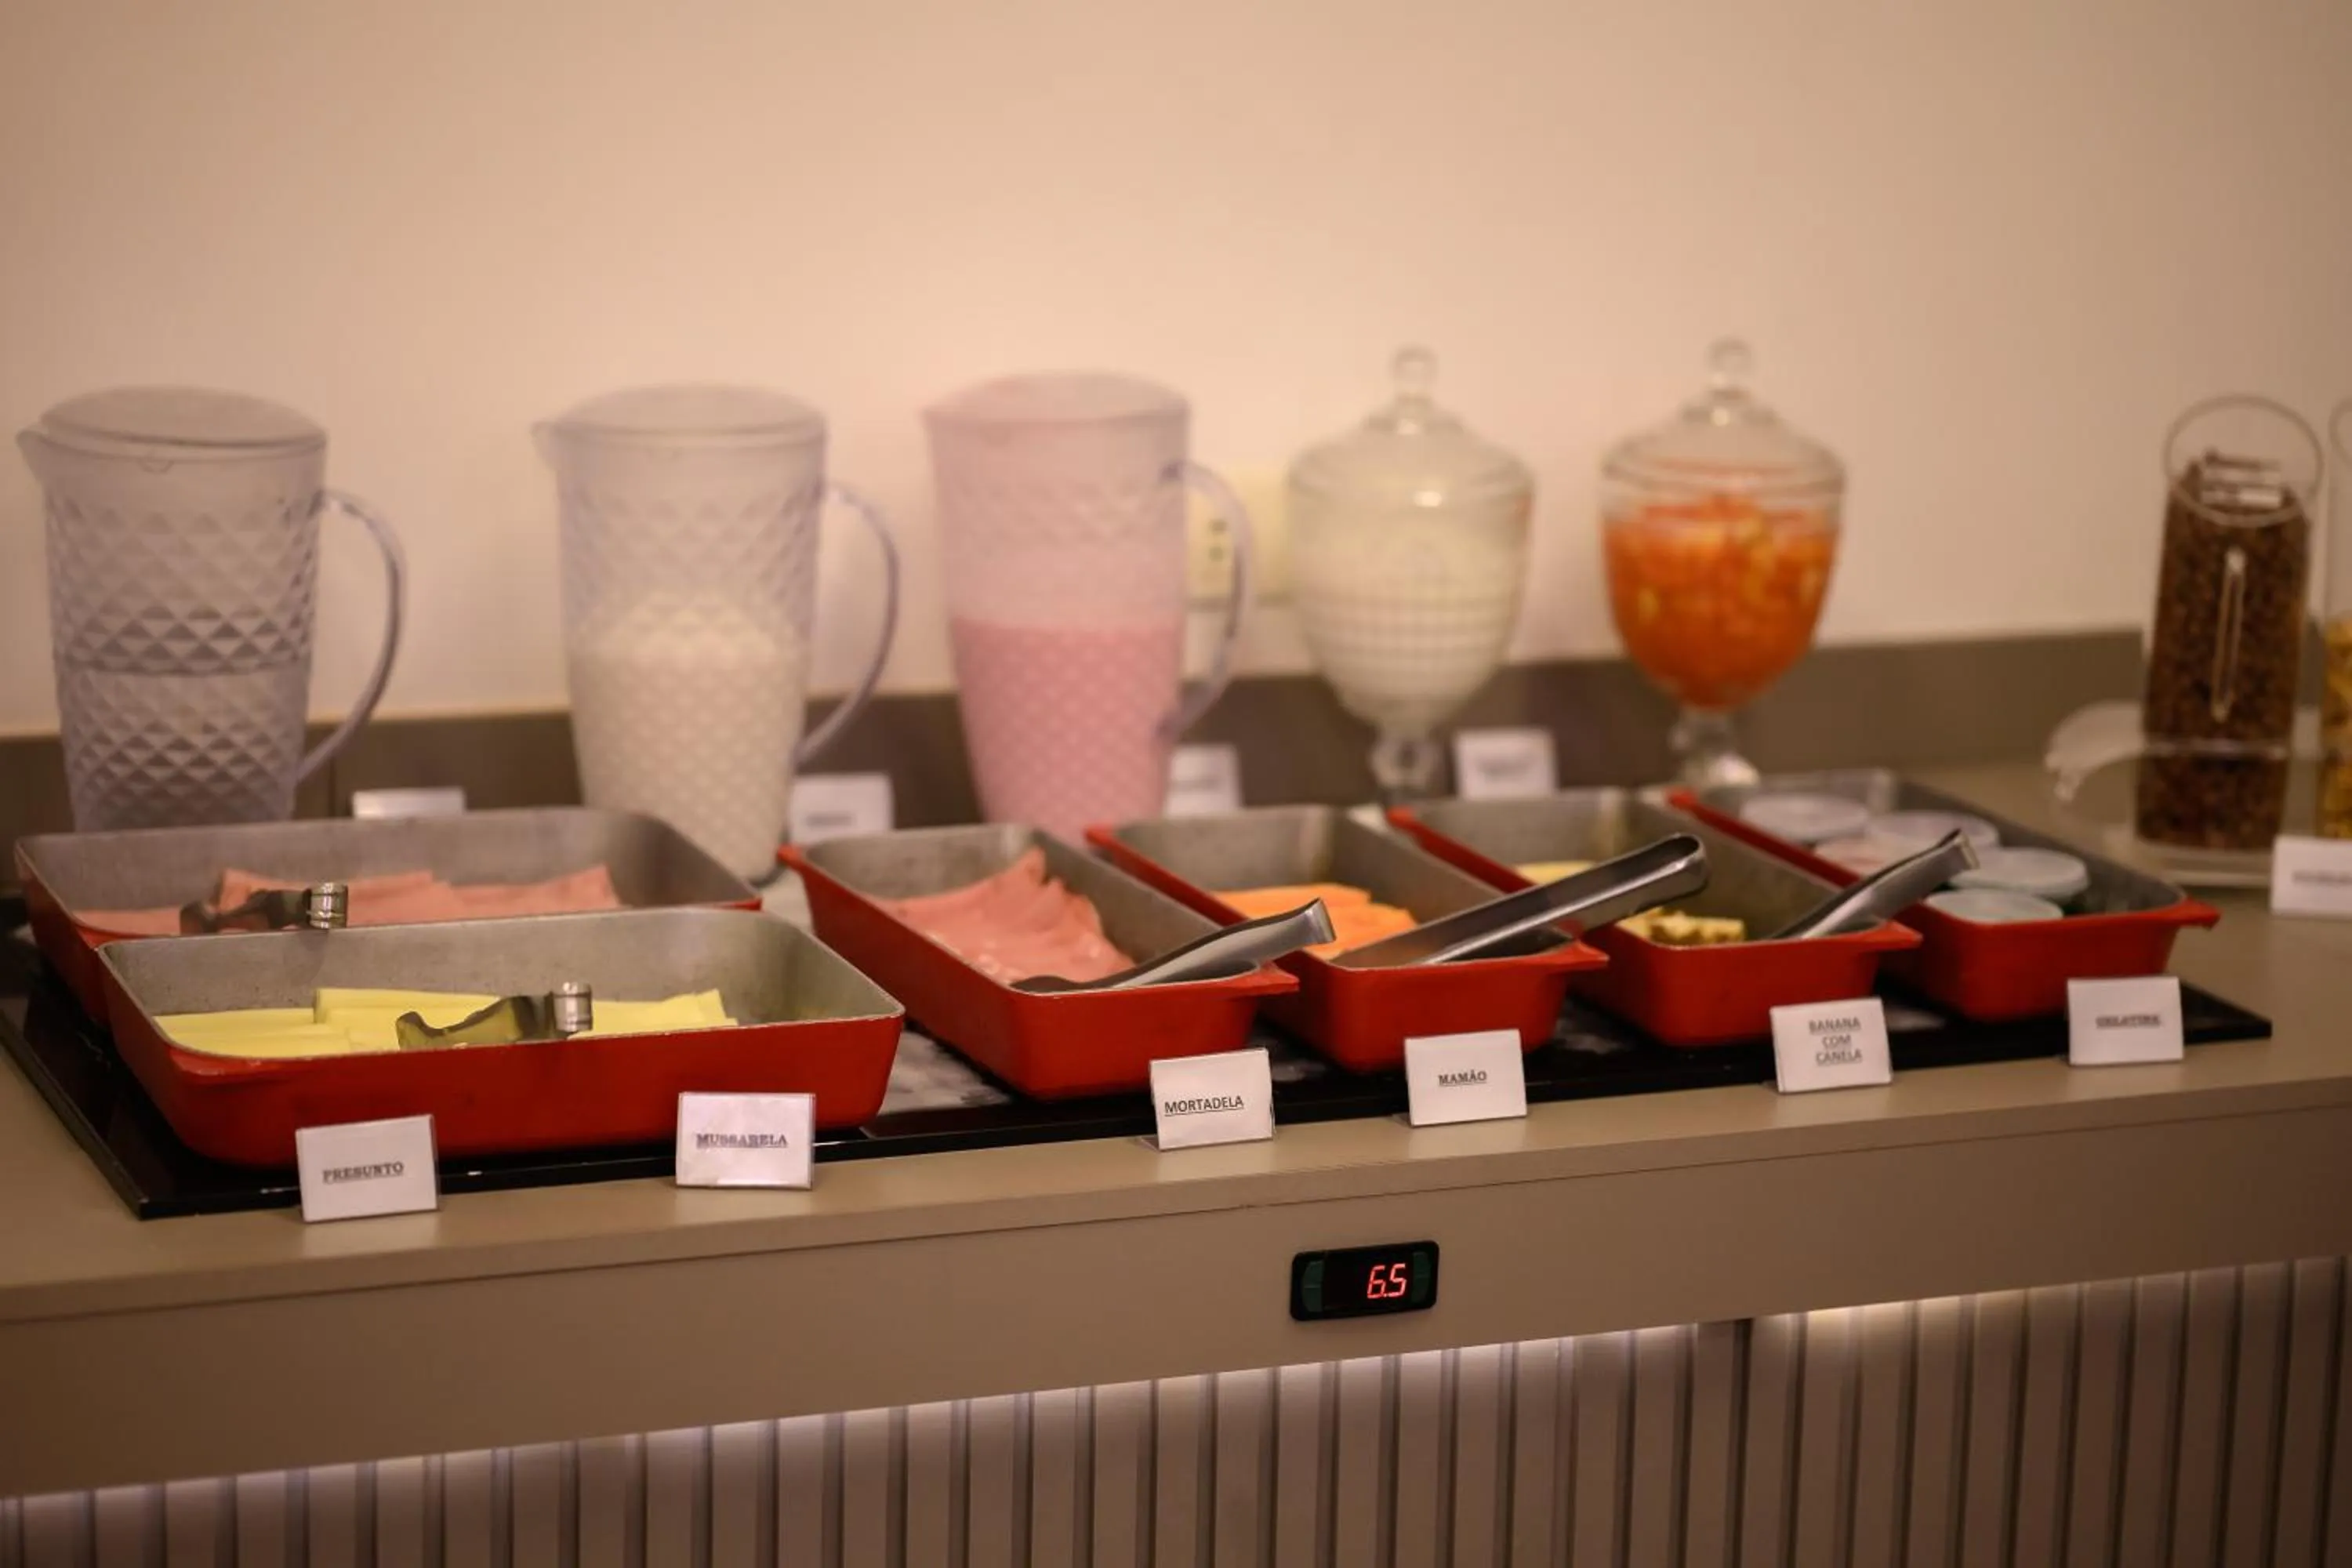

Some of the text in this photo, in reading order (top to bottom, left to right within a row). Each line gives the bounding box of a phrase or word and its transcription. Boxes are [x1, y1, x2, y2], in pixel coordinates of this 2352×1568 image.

[1809, 1017, 1861, 1033] BANANA
[1822, 1034, 1851, 1047] COM
[1815, 1048, 1863, 1065] CANELA
[1438, 1069, 1488, 1086] MAMÃO
[1164, 1095, 1244, 1116] MORTADELA
[696, 1134, 788, 1149] MUSSARELA
[322, 1161, 405, 1184] PRESUNTO
